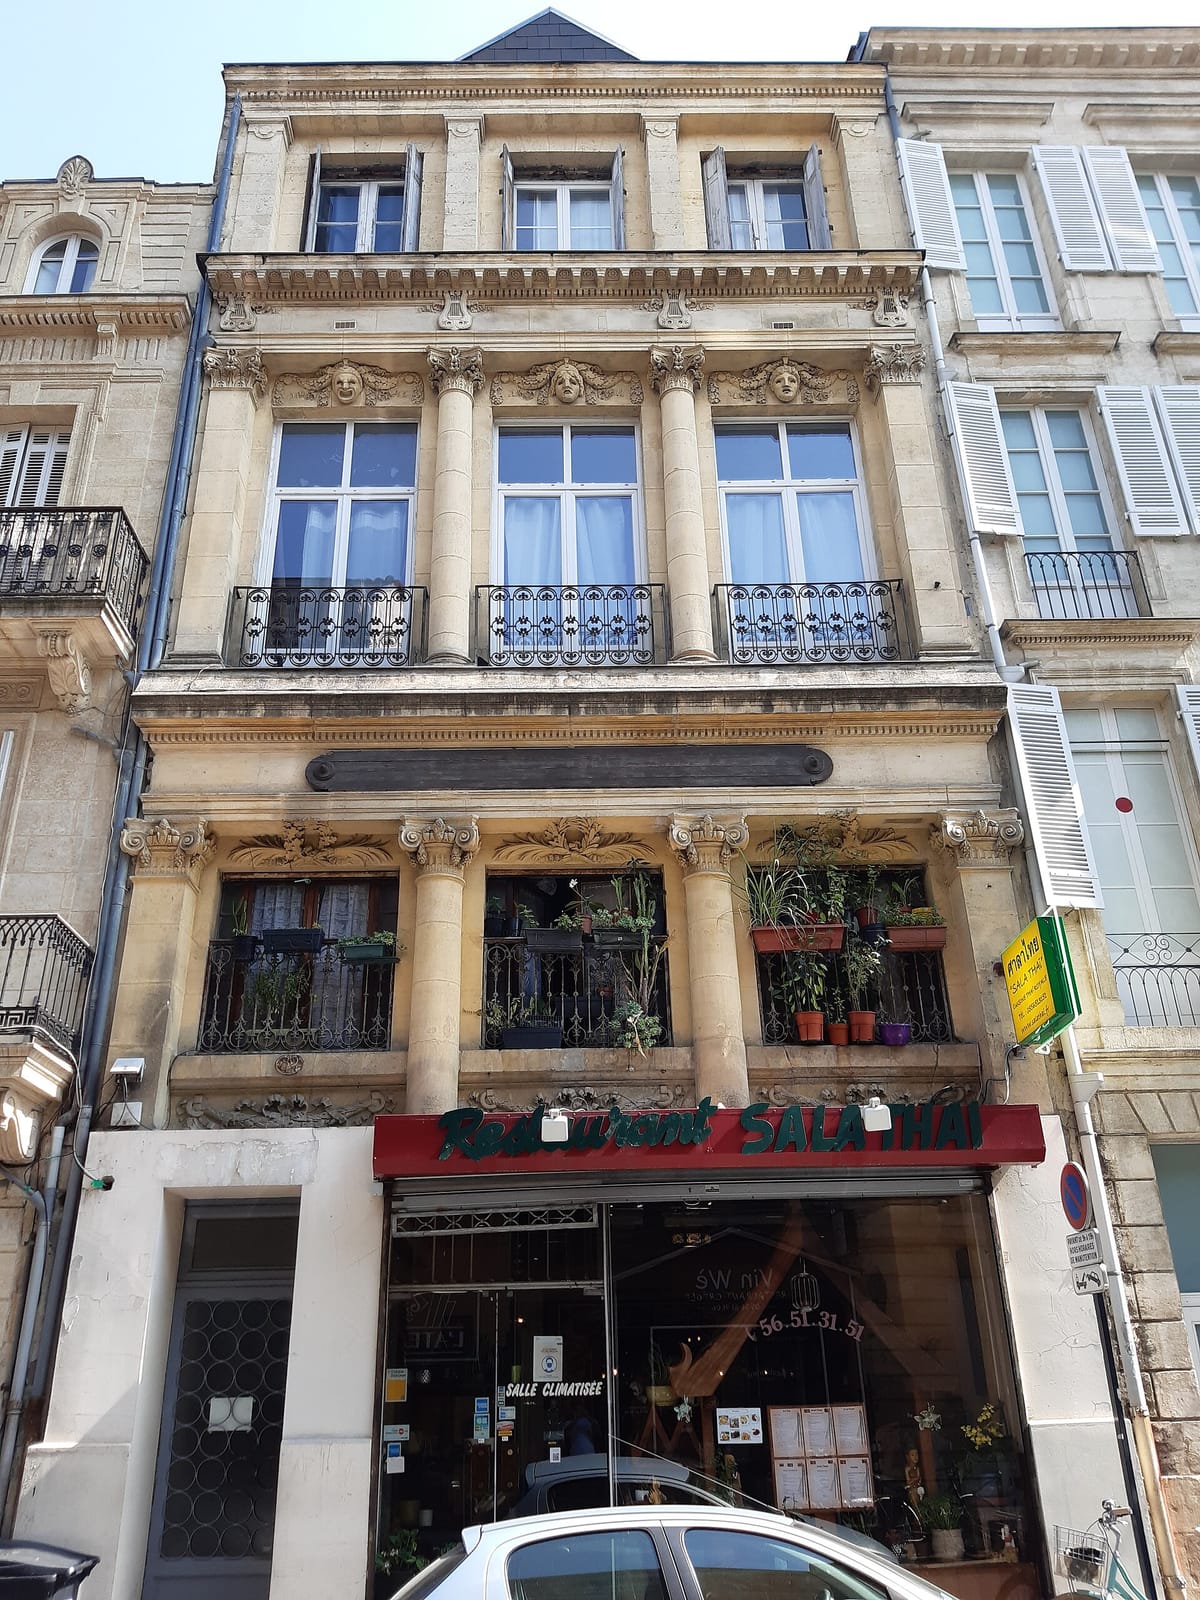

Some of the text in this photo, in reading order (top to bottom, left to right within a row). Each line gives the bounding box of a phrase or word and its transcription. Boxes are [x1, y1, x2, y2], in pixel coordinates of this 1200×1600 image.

[438, 1096, 983, 1161] Resturant SALA THAI
[505, 1379, 603, 1398] SALLE CLIMATISÉE
